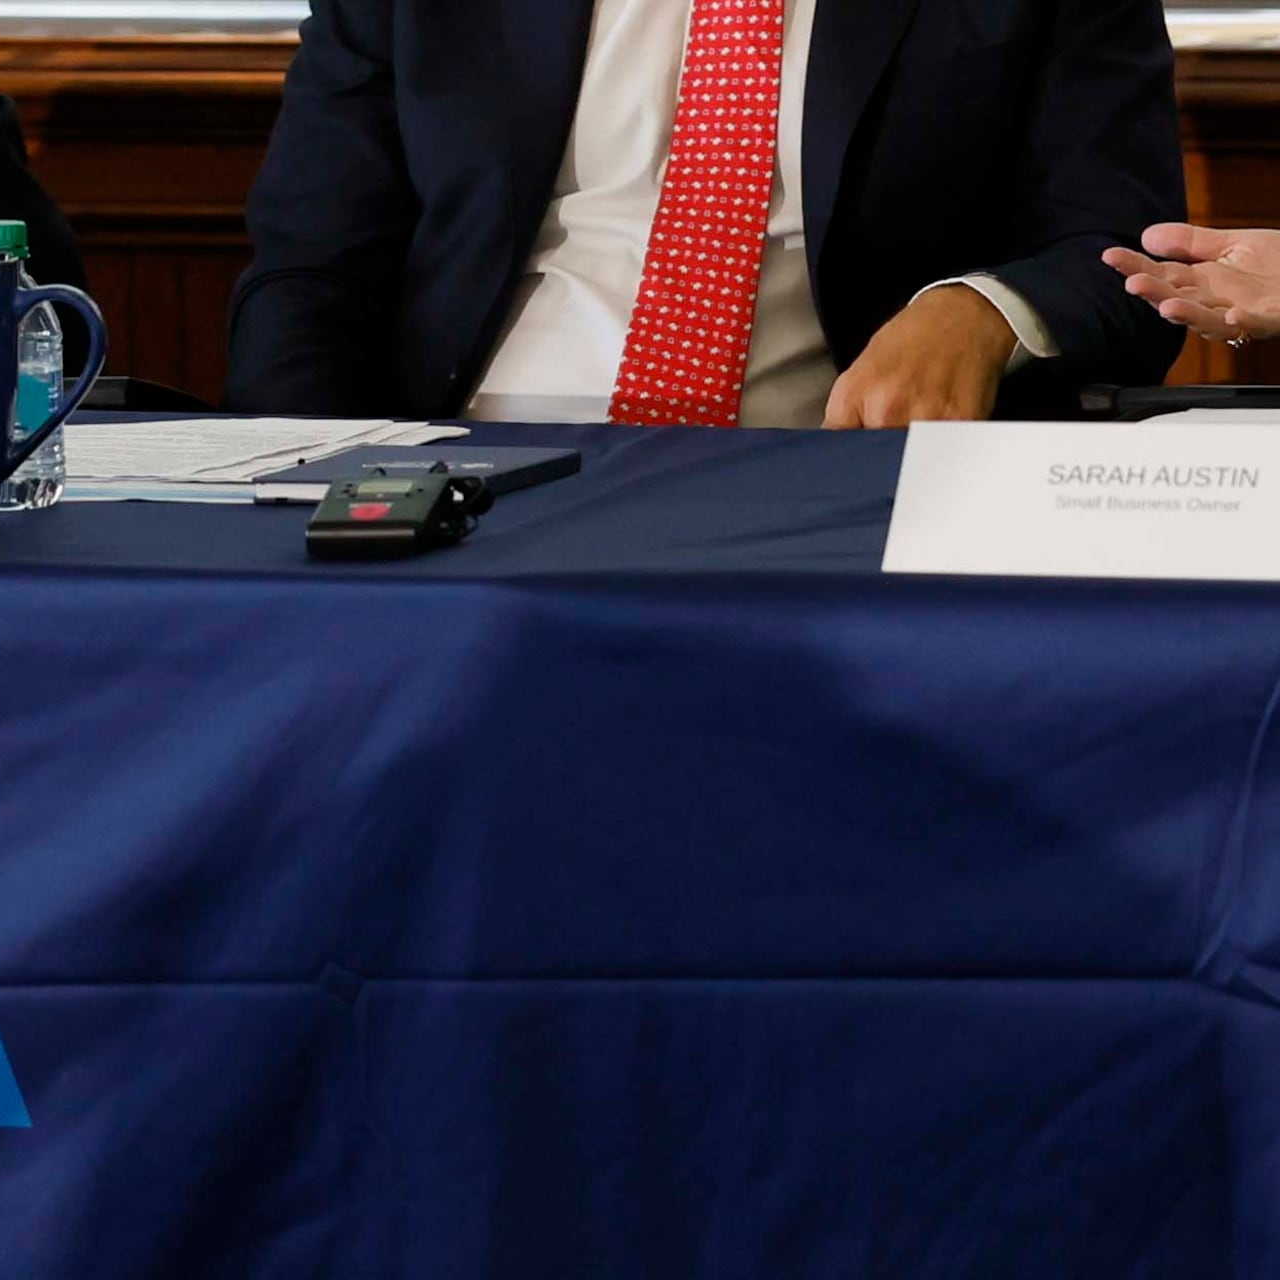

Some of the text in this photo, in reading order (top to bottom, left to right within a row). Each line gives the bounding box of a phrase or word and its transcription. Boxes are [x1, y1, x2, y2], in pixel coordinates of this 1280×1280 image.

[1047, 464, 1260, 488] SARAH AUSTIN
[1056, 494, 1241, 512] Small Business Owner
